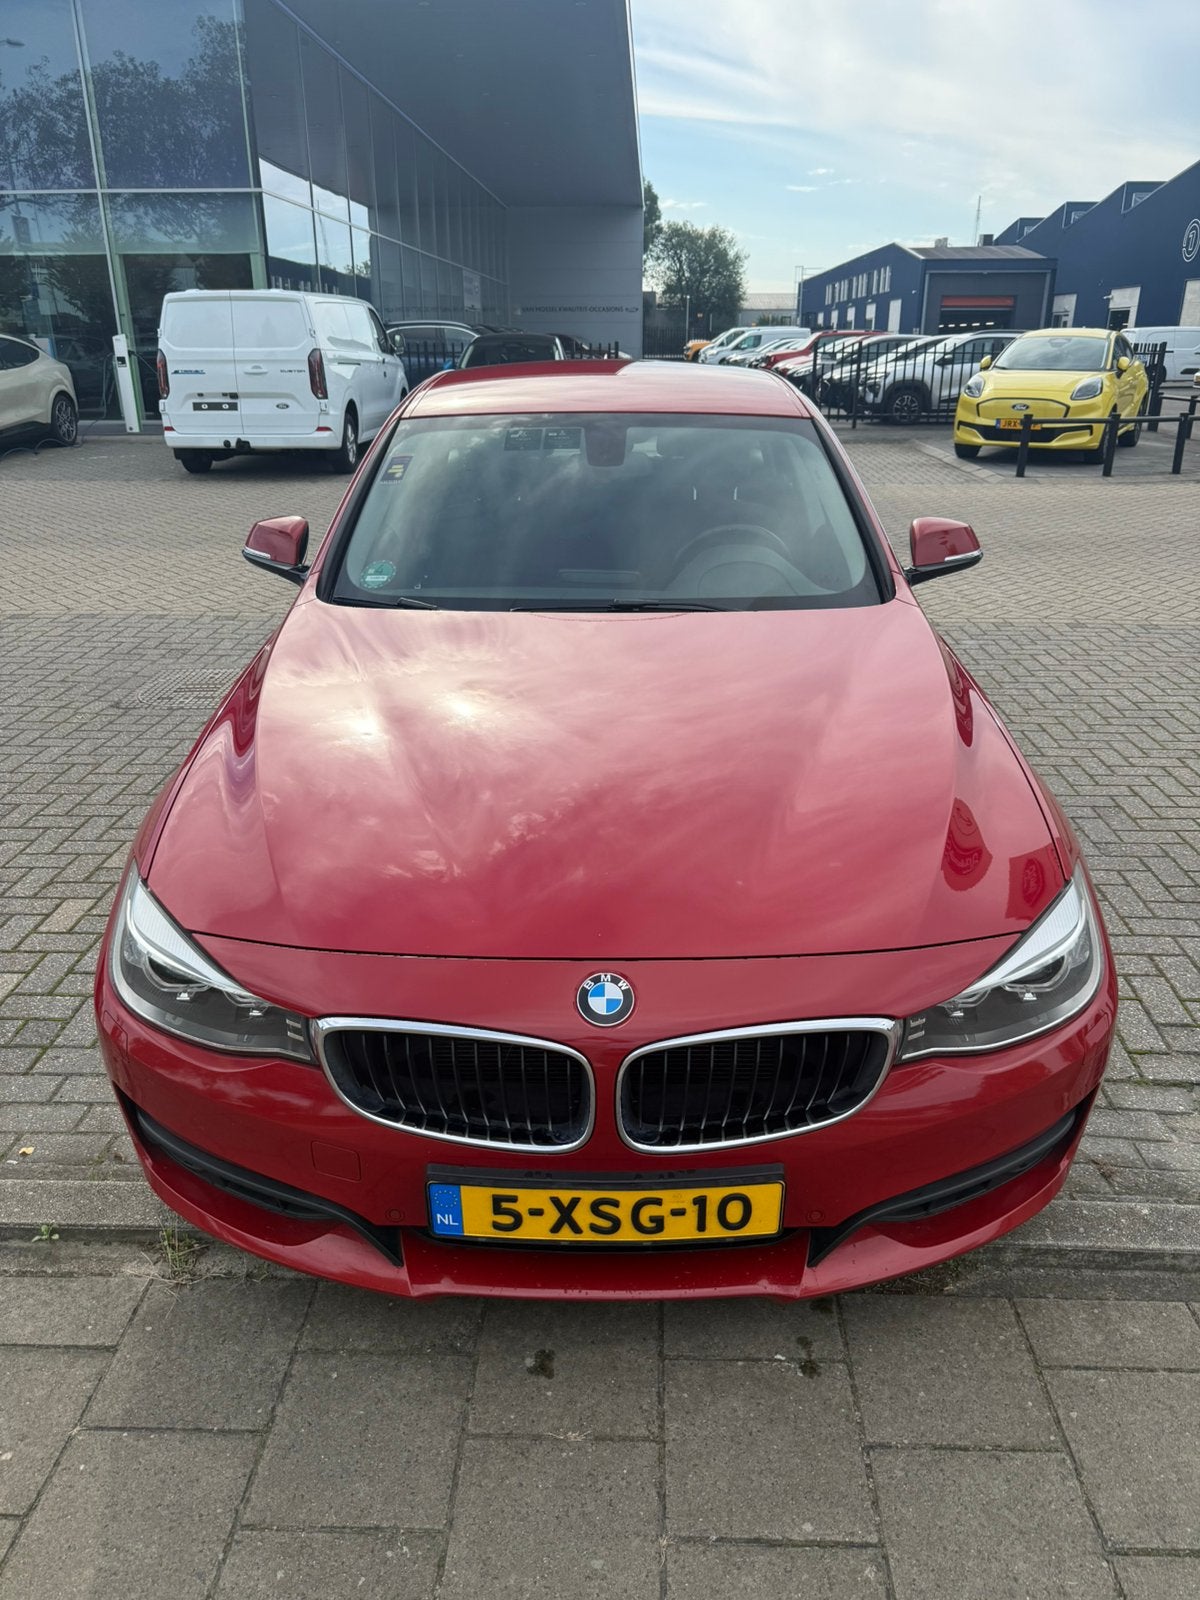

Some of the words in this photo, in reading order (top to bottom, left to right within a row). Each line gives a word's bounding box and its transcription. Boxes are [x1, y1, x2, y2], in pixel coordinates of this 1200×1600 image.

[583, 974, 629, 990] BMW
[436, 1213, 460, 1226] NL
[491, 1192, 753, 1236] 5-XSG-10
